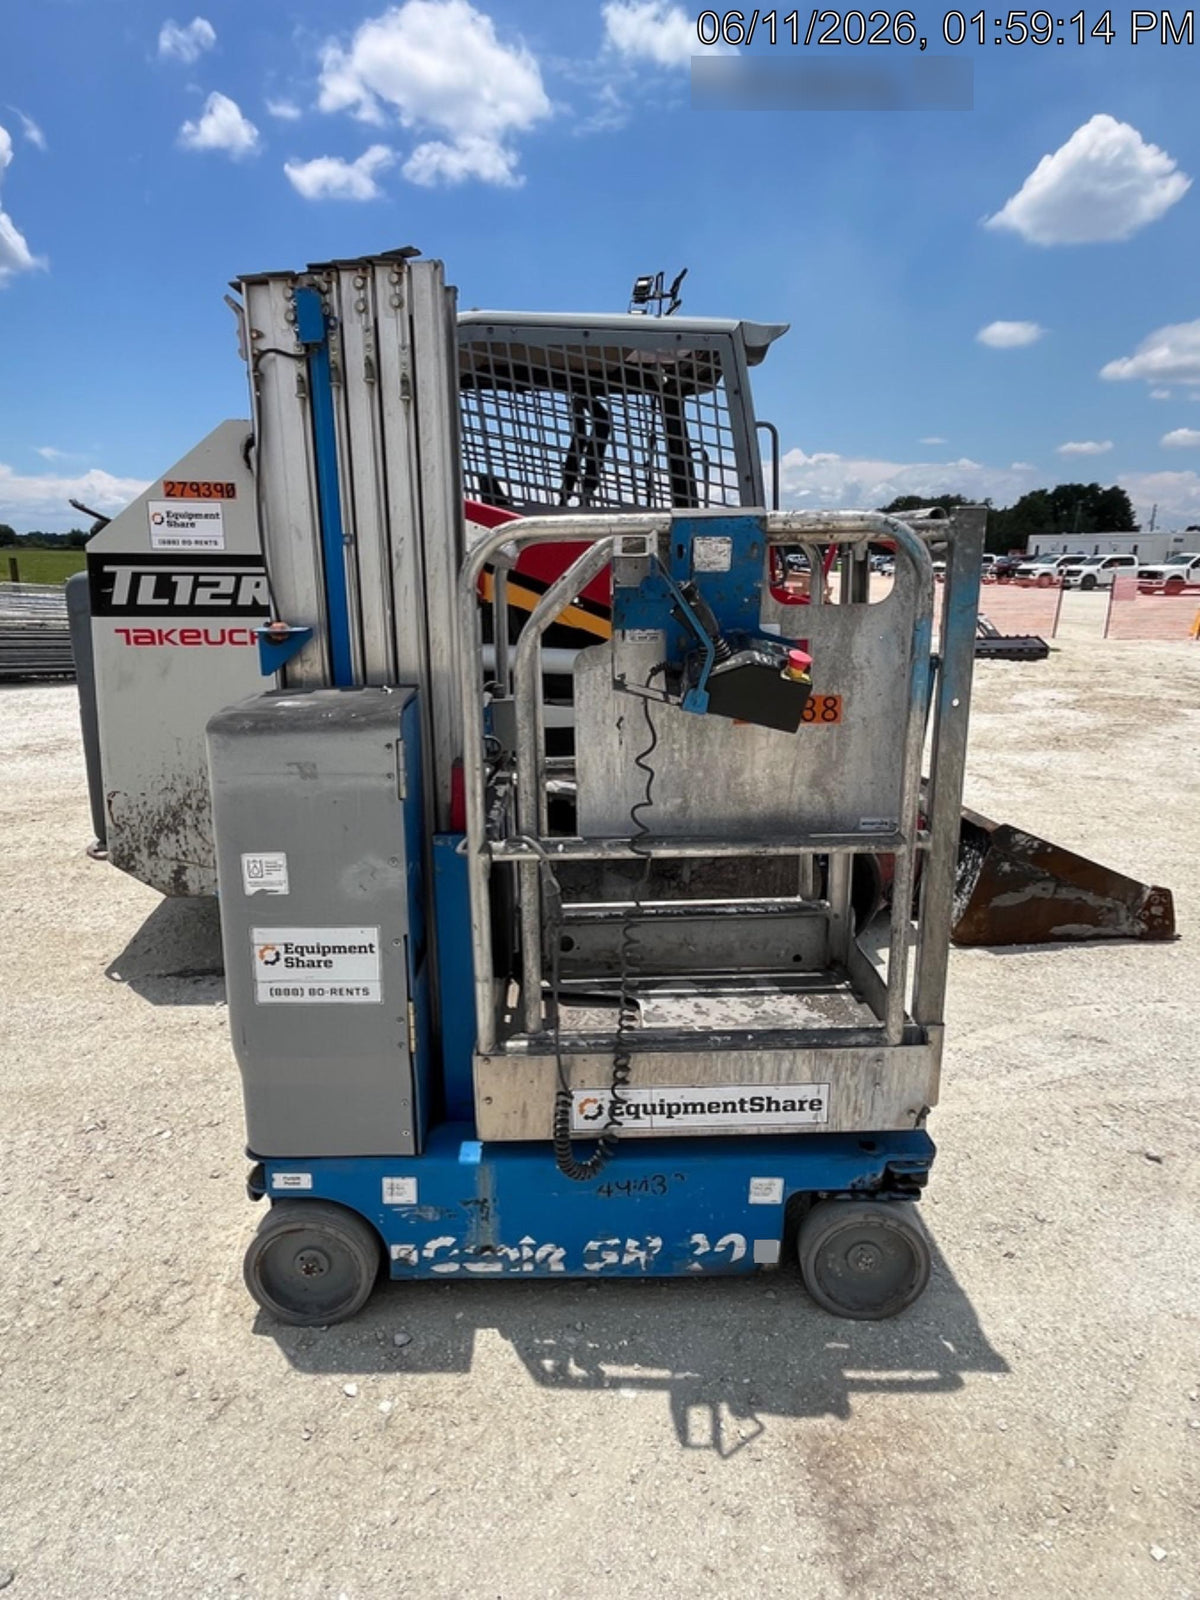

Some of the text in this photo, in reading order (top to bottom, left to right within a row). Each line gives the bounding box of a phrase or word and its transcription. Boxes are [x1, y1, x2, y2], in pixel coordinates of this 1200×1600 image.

[164, 481, 236, 499] 279390
[165, 510, 221, 521] Equipment
[166, 520, 196, 528] Share
[284, 942, 376, 957] Equipment
[284, 957, 334, 969] Share
[269, 987, 371, 997] (888) 80-RENTS
[609, 1096, 823, 1120] EquipmentShare
